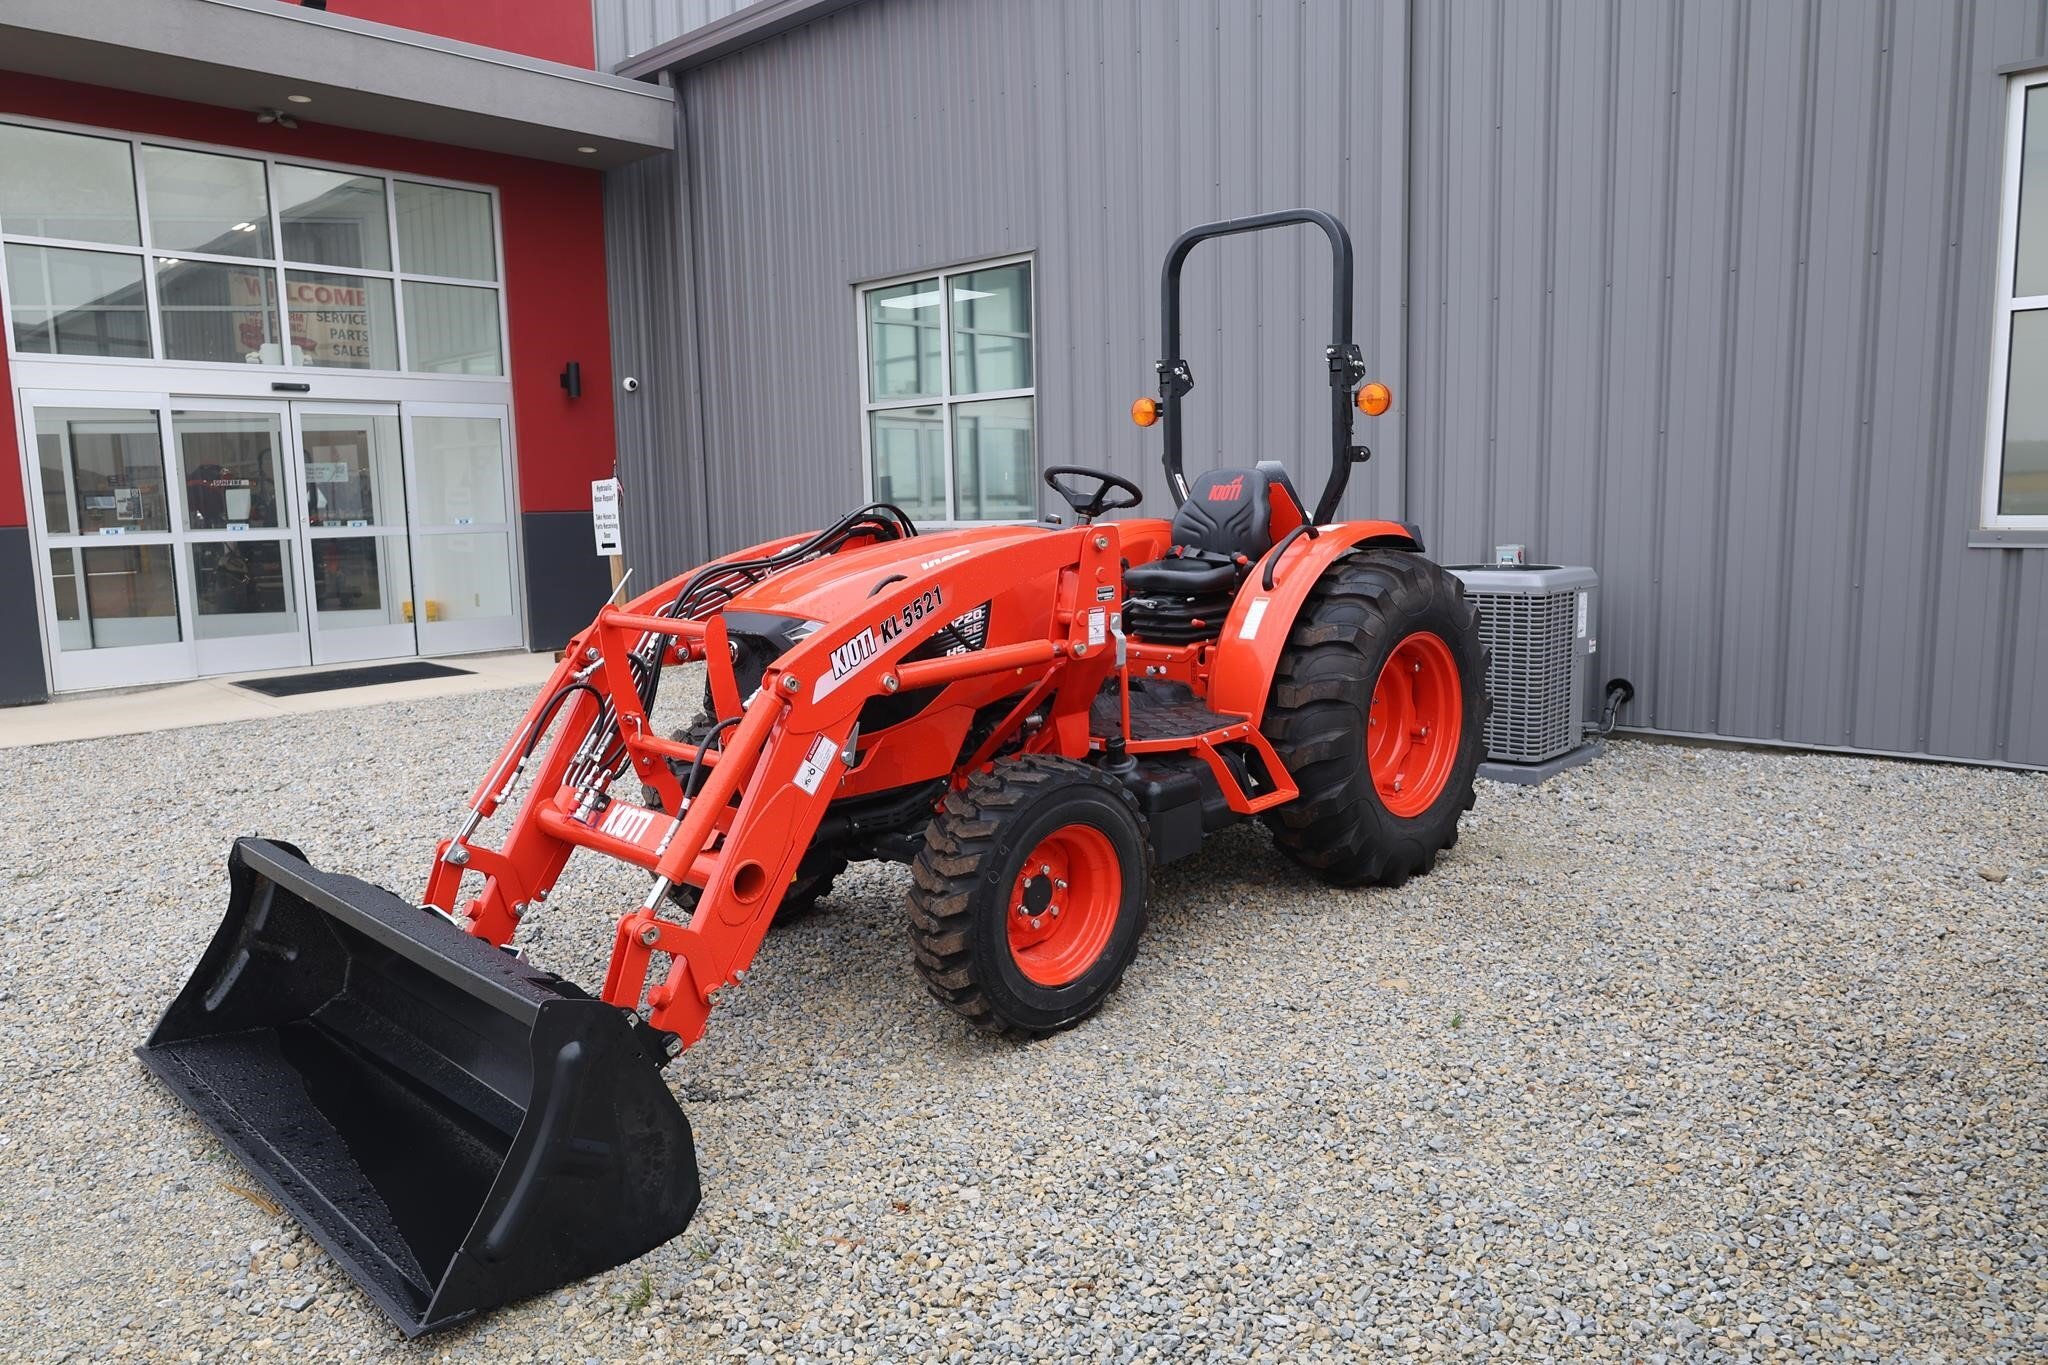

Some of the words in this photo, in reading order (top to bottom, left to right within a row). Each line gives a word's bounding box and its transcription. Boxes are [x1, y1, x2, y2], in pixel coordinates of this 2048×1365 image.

[316, 311, 367, 326] SERVICE
[330, 328, 369, 342] PARTS
[333, 344, 370, 357] SALES
[597, 484, 612, 492] Hydraulic
[1208, 483, 1243, 500] KIOTI
[603, 494, 615, 503] Repair?
[963, 622, 984, 637] SE
[829, 625, 877, 680] KIOTI
[600, 803, 656, 844] KIOTI
